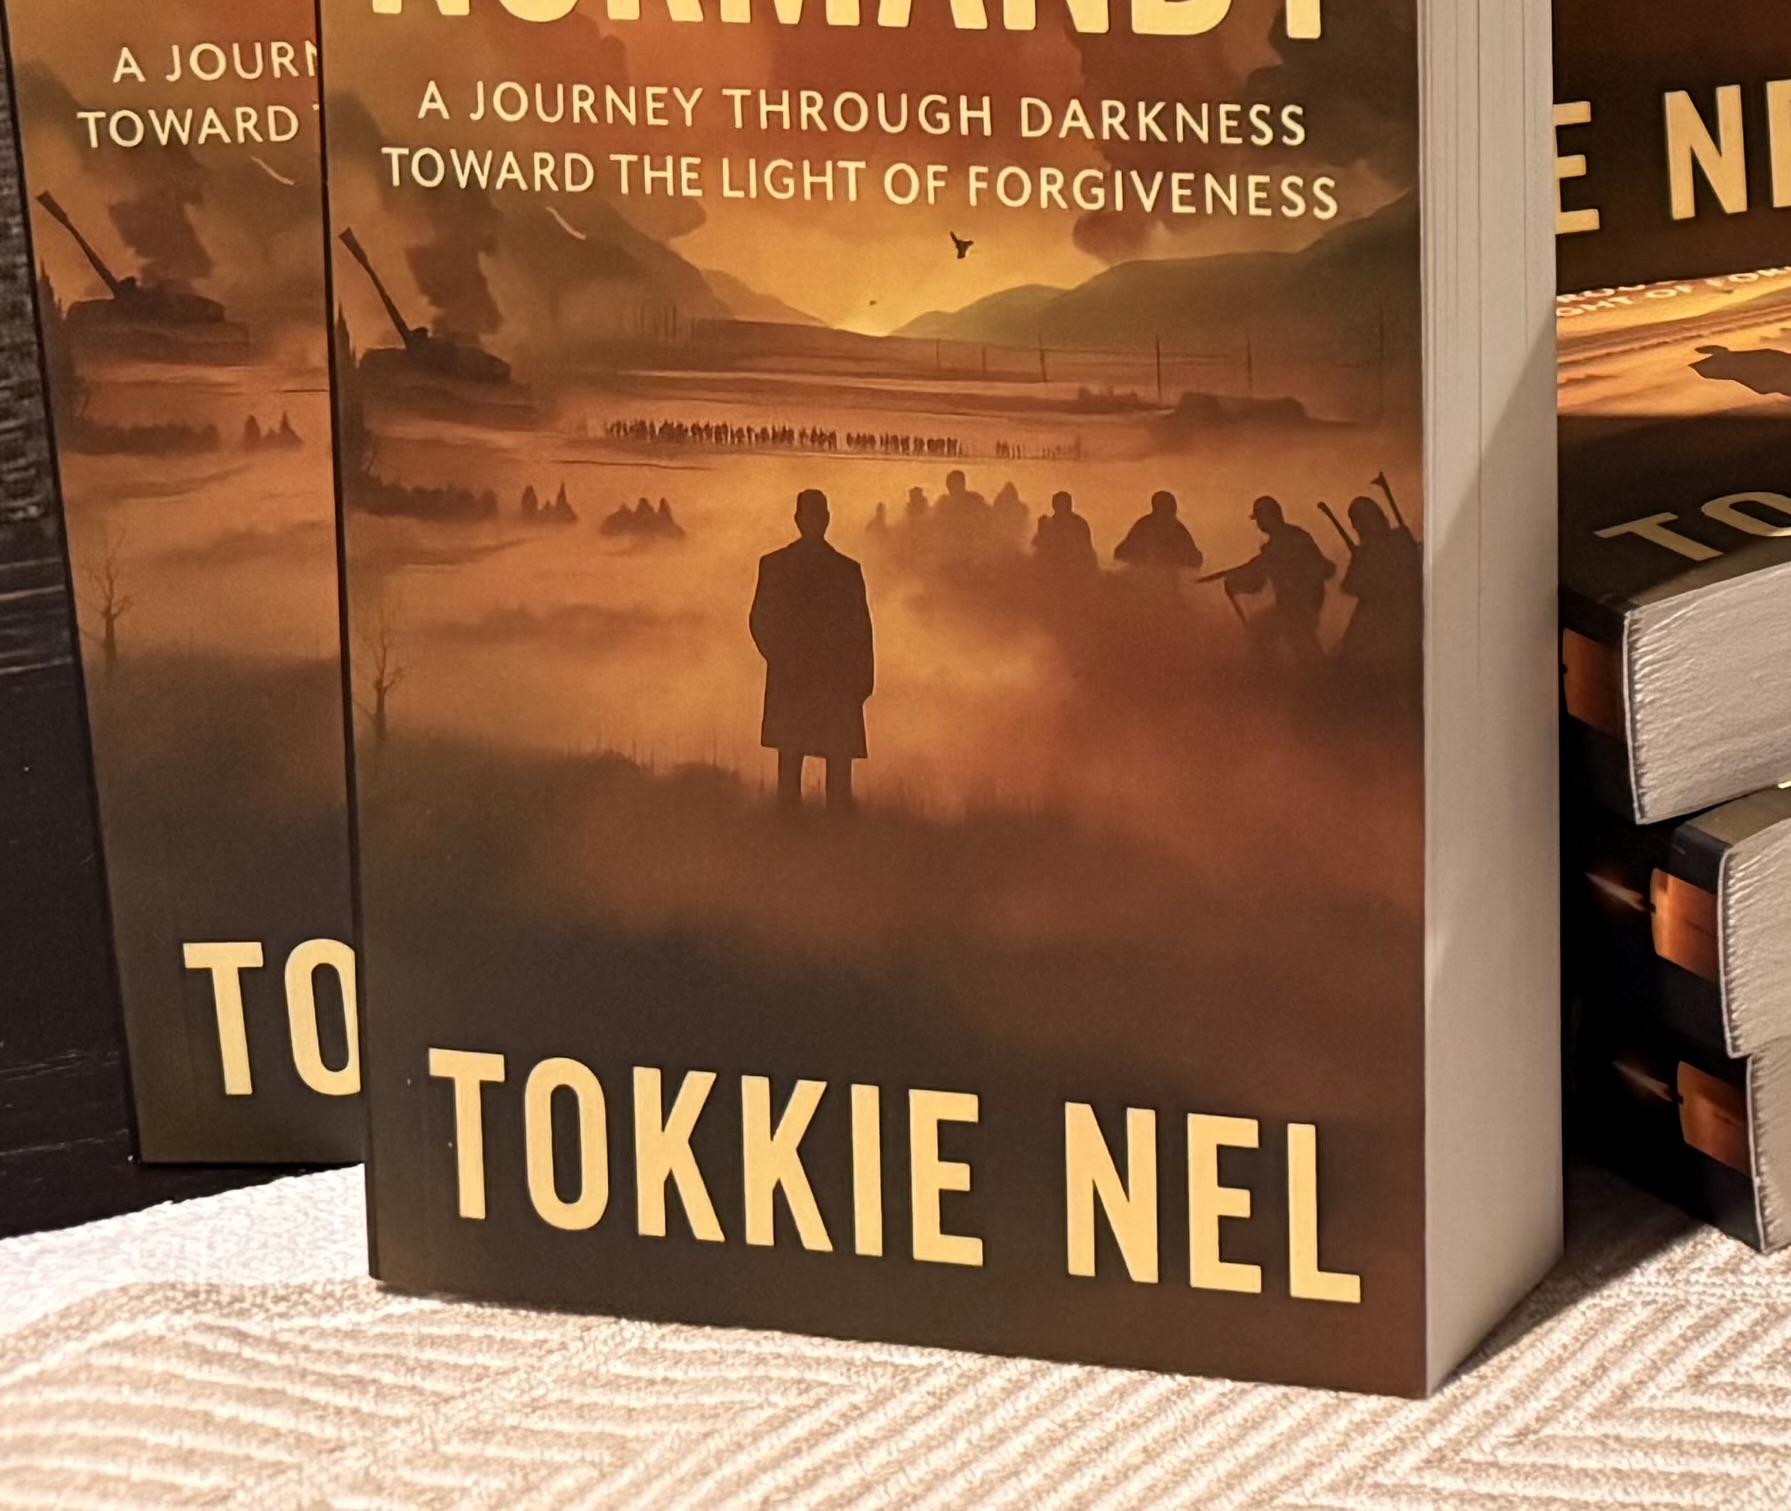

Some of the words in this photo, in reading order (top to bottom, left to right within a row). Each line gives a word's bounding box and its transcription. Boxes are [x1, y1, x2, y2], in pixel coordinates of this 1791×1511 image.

[113, 46, 146, 83] A
[77, 106, 300, 150] TOWARD
[417, 80, 450, 120] A
[469, 80, 703, 127] JOURNEY
[721, 88, 992, 137] THROUGH
[1020, 97, 1305, 146] DARKNESS
[381, 146, 595, 192] TOWARD
[609, 153, 703, 197] THE
[722, 157, 867, 202] LIGHT
[883, 162, 948, 205] OF
[968, 165, 1338, 220] FORGIVENESS
[428, 1047, 984, 1267] TOKKIE
[1064, 1101, 1361, 1304] NEL
